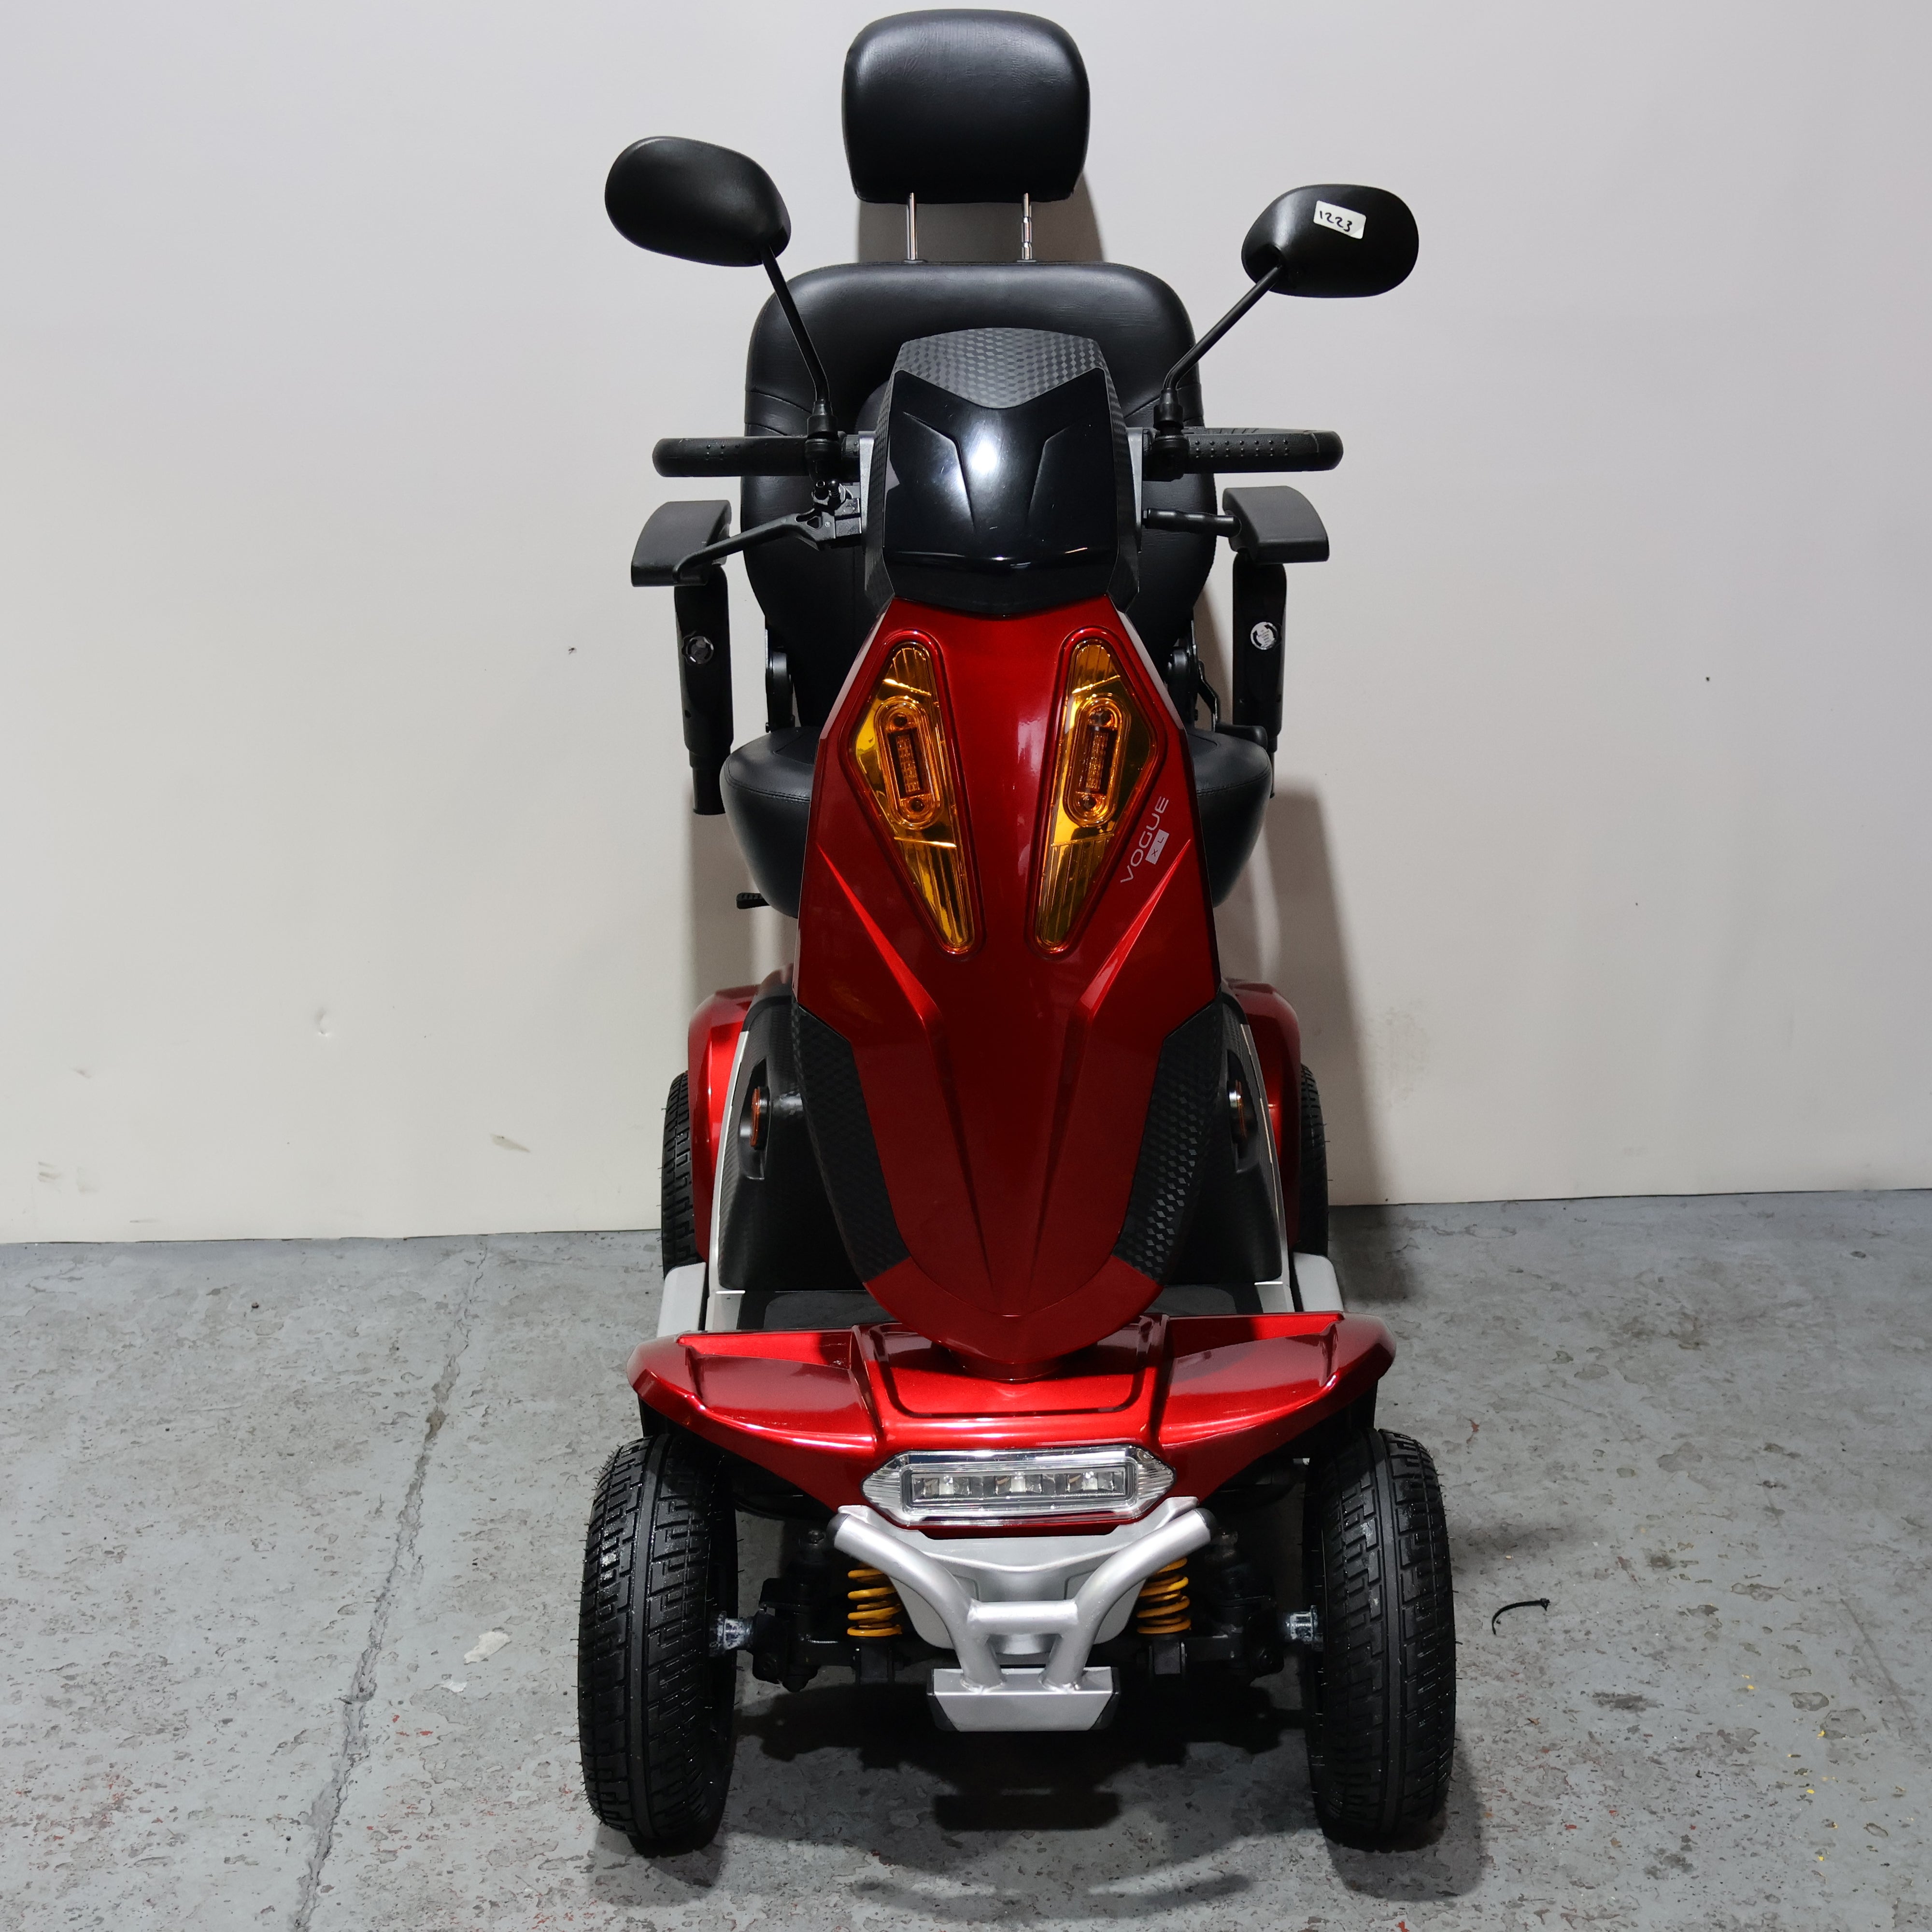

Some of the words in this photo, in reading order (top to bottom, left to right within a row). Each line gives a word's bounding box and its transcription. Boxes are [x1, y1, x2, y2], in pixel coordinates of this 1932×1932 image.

[1320, 211, 1352, 232] 1223
[1120, 796, 1169, 883] VOGUE
[1151, 837, 1165, 857] XL
